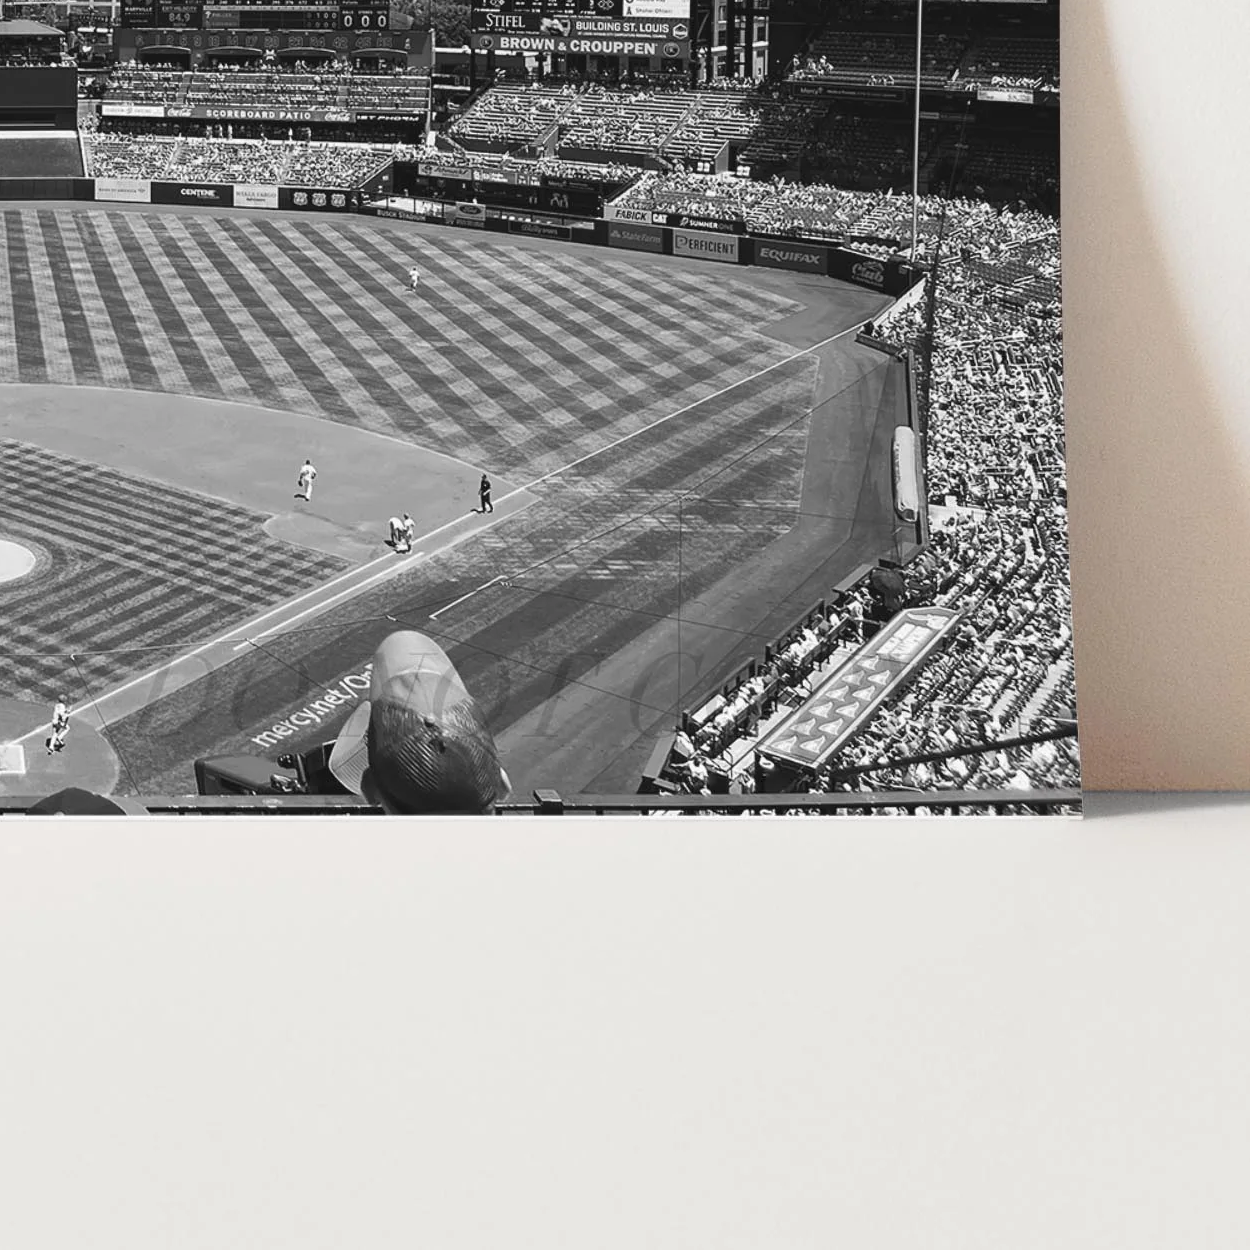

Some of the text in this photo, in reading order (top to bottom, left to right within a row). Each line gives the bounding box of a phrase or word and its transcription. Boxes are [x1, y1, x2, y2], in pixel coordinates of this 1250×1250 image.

[344, 15, 386, 27] 0 0 0
[486, 13, 525, 28] STIFEL
[575, 21, 670, 33] BUILDING ST. LOUIS
[500, 36, 656, 55] BROWN & CROUPPEN
[206, 109, 311, 120] SCOREBOARD PATIO
[615, 210, 648, 222] FABICK
[652, 213, 668, 225] CAT
[675, 235, 735, 256] PERFICIENT
[760, 247, 821, 265] EQUIFAX
